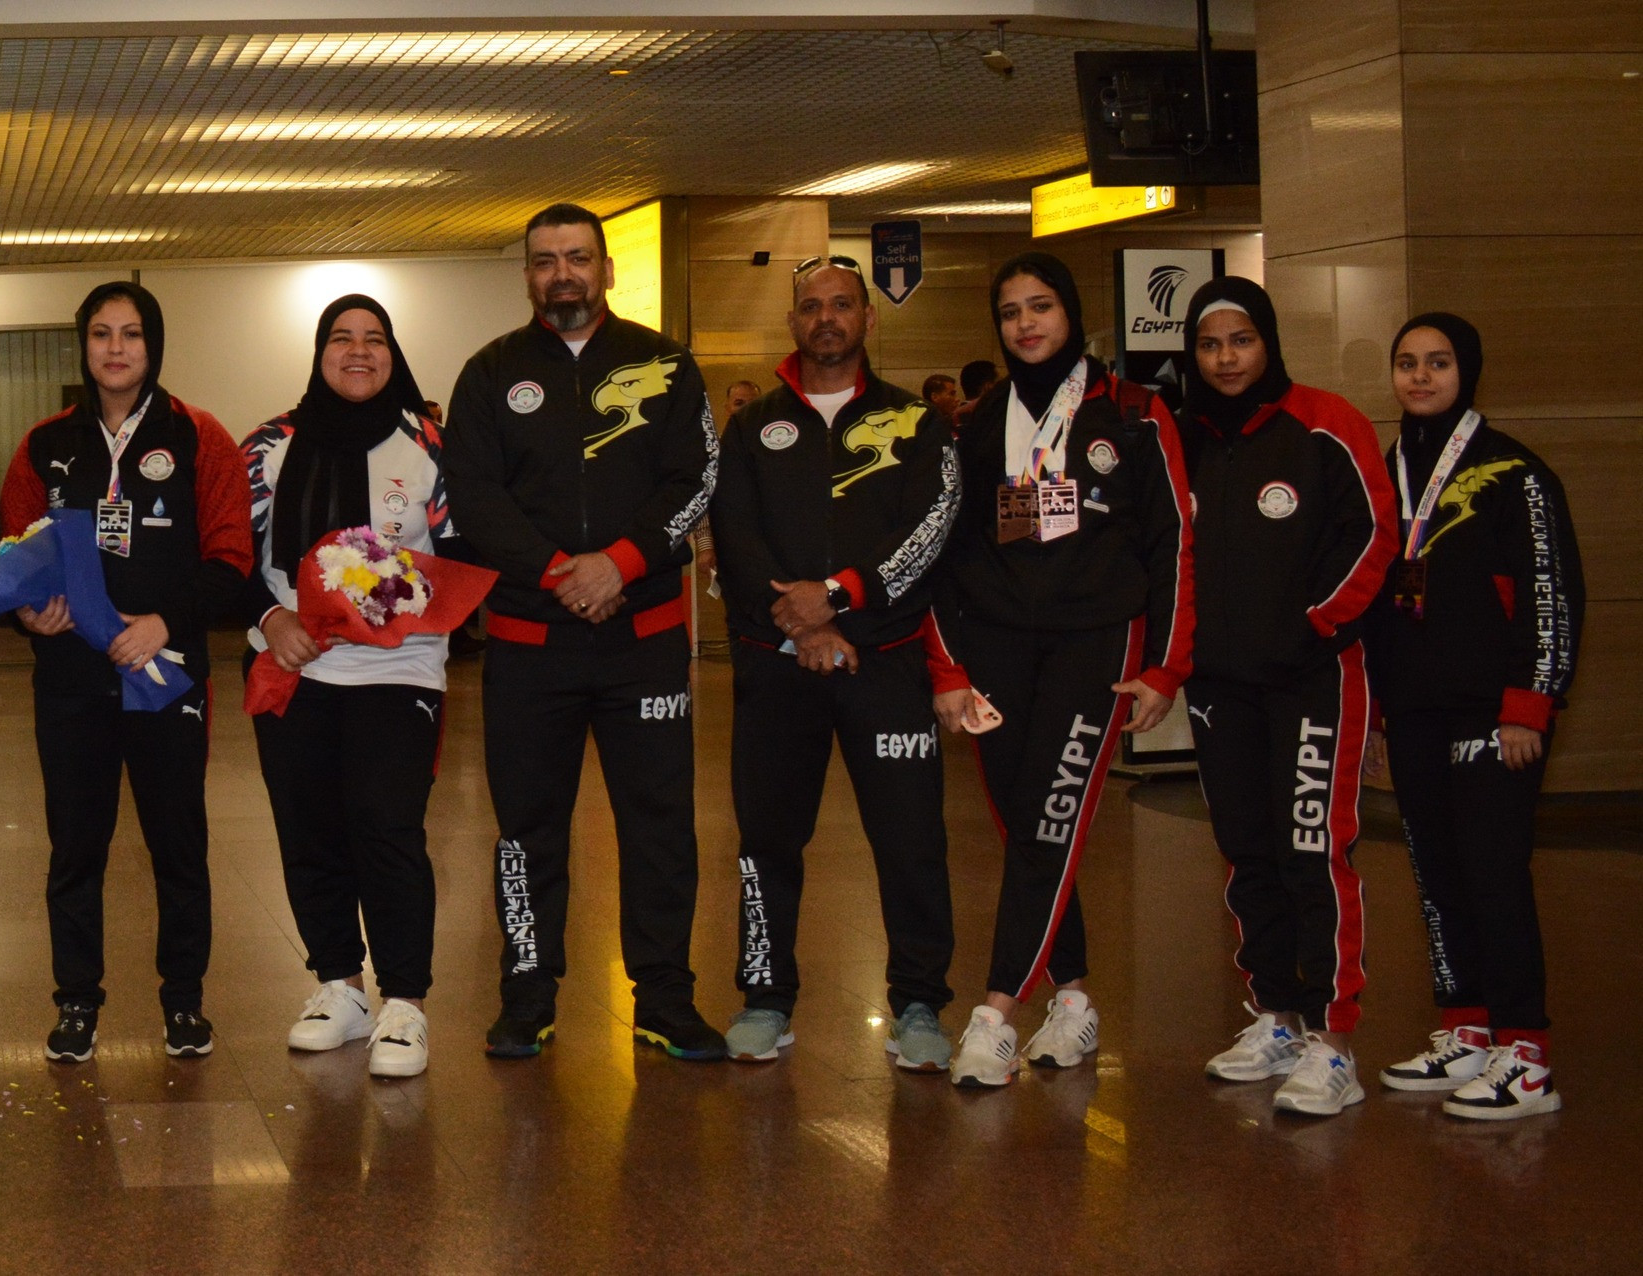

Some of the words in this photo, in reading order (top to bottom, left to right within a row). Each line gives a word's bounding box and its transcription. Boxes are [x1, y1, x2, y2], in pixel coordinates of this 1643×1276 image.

[1034, 210, 1062, 225] Domestic
[1063, 201, 1099, 219] Departures
[875, 252, 920, 265] Check-in
[887, 243, 907, 255] Self
[1131, 317, 1185, 334] EGYPT
[1036, 713, 1102, 845] EGYPT
[1292, 717, 1333, 853] EGYPT
